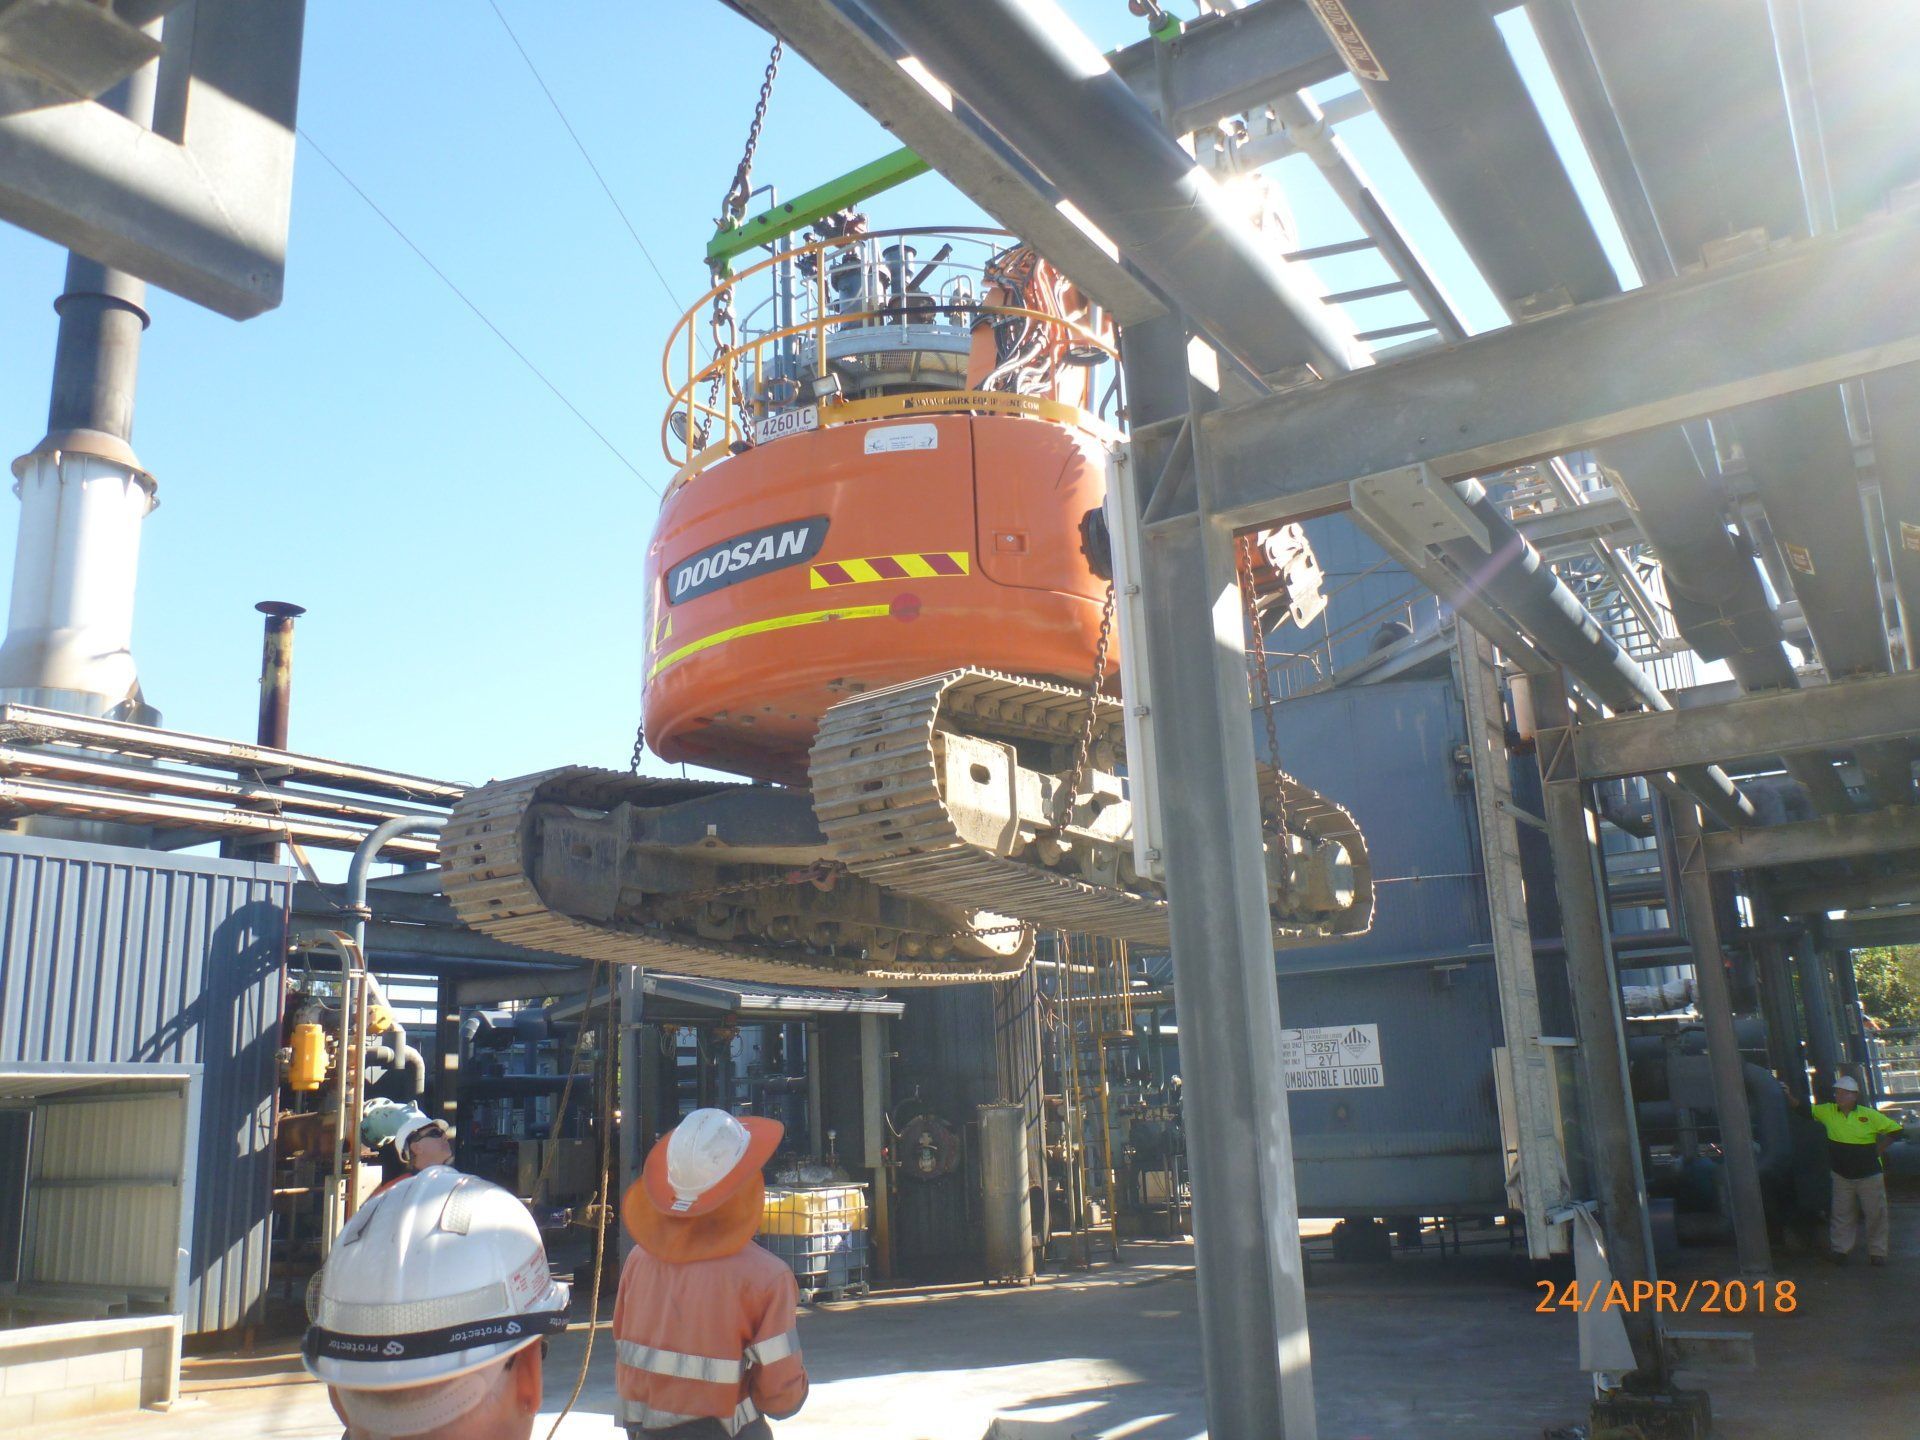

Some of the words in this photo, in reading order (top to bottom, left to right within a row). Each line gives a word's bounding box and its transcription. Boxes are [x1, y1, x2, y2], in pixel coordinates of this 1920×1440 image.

[675, 527, 809, 597] DOOSAN
[1311, 1042, 1337, 1053] 3257
[1318, 1054, 1334, 1066] 2Y
[1284, 1069, 1339, 1088] OMBUSTIBLE
[1343, 1067, 1379, 1086] LIQUID
[450, 1325, 504, 1343] Protector
[328, 1340, 379, 1354] Protector
